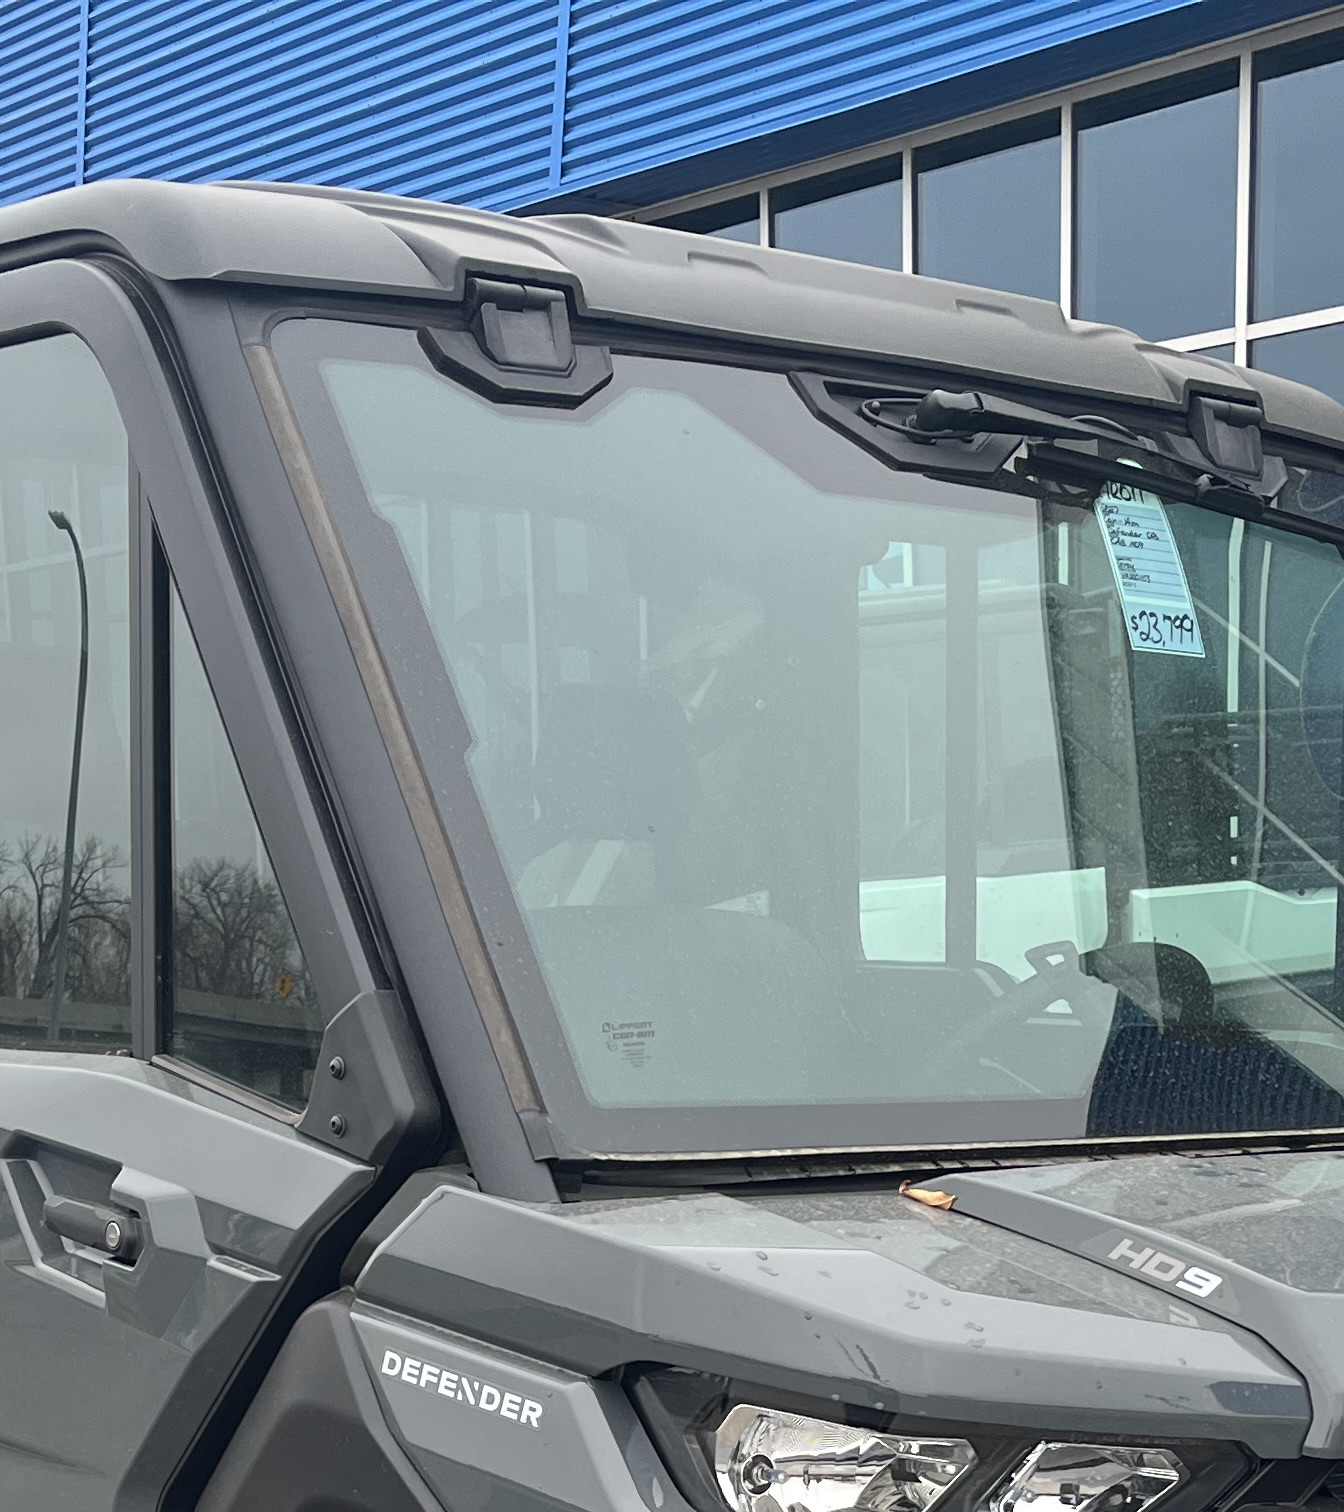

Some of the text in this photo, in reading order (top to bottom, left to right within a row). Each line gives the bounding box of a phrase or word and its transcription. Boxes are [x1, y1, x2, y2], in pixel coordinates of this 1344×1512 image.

[1130, 610, 1195, 647] $23,799
[1107, 1238, 1224, 1299] HD9
[381, 1349, 544, 1428] DEFENDER
